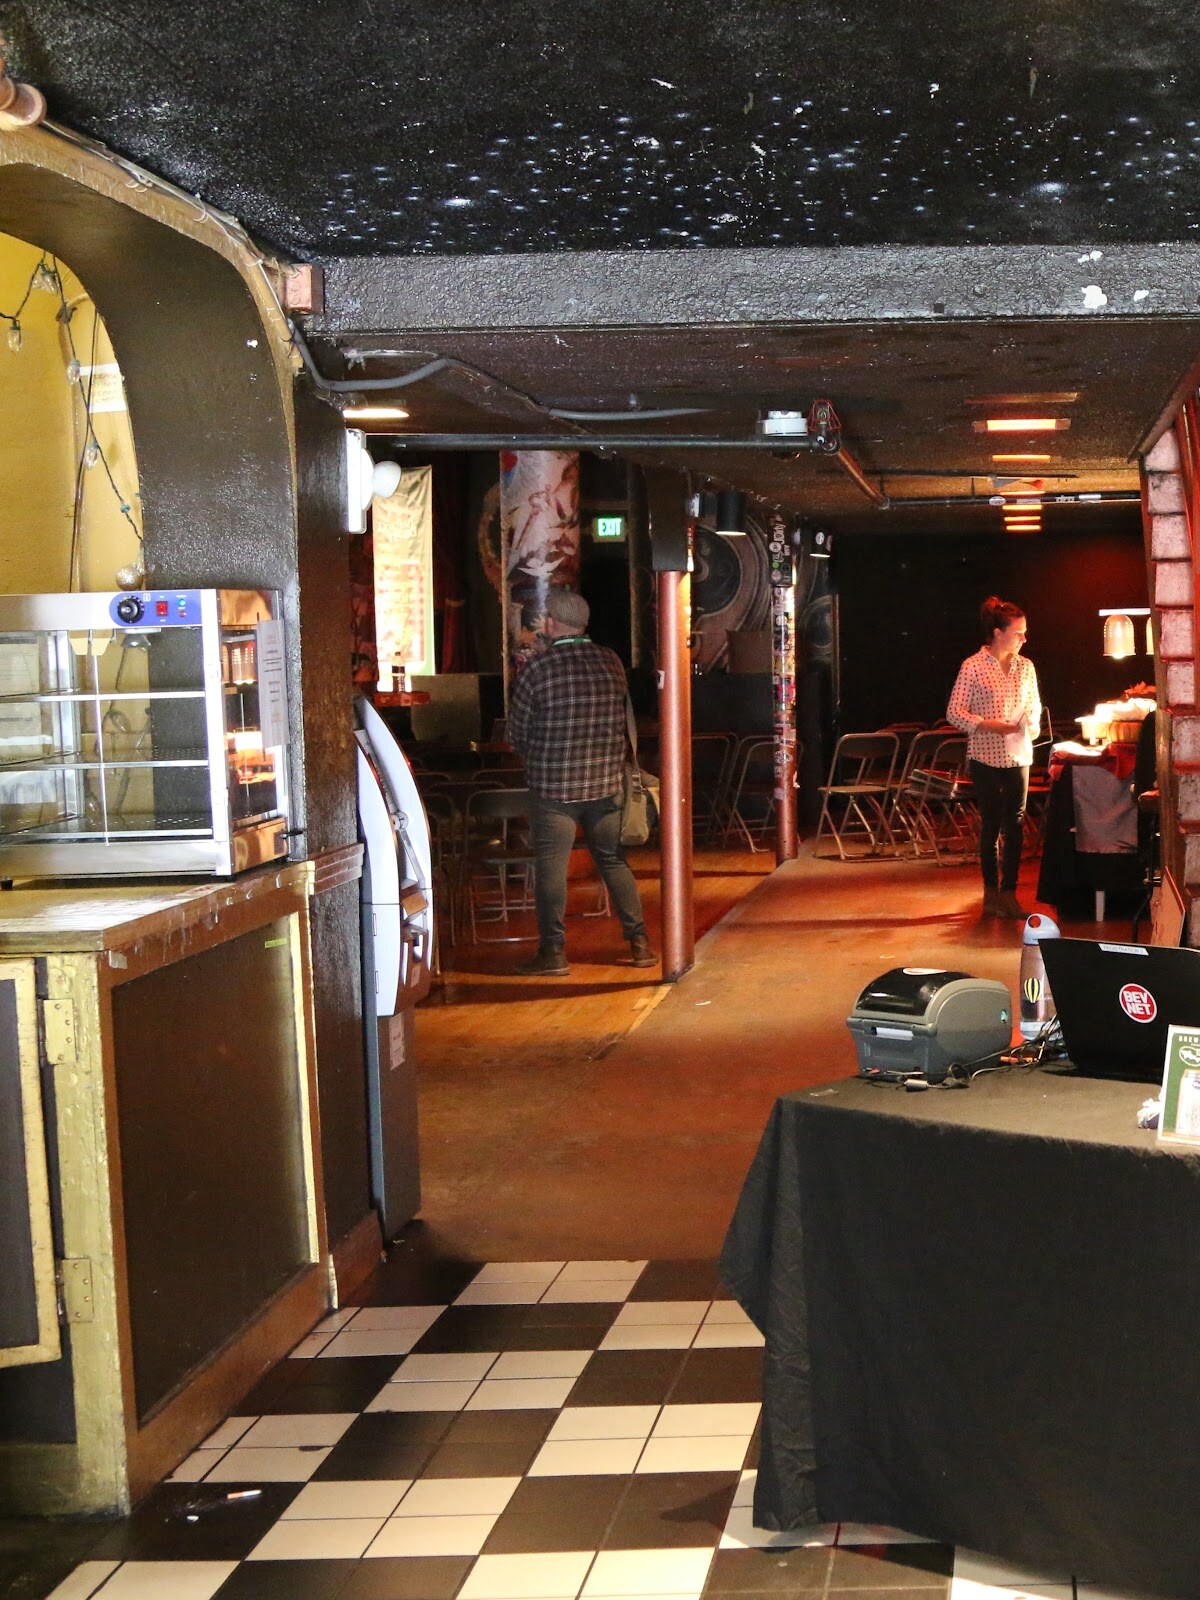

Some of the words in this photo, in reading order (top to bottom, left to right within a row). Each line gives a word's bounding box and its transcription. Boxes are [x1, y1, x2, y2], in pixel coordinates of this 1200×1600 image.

[598, 518, 621, 536] EXIT
[1122, 991, 1148, 1003] BEV
[1126, 1002, 1151, 1015] NET
